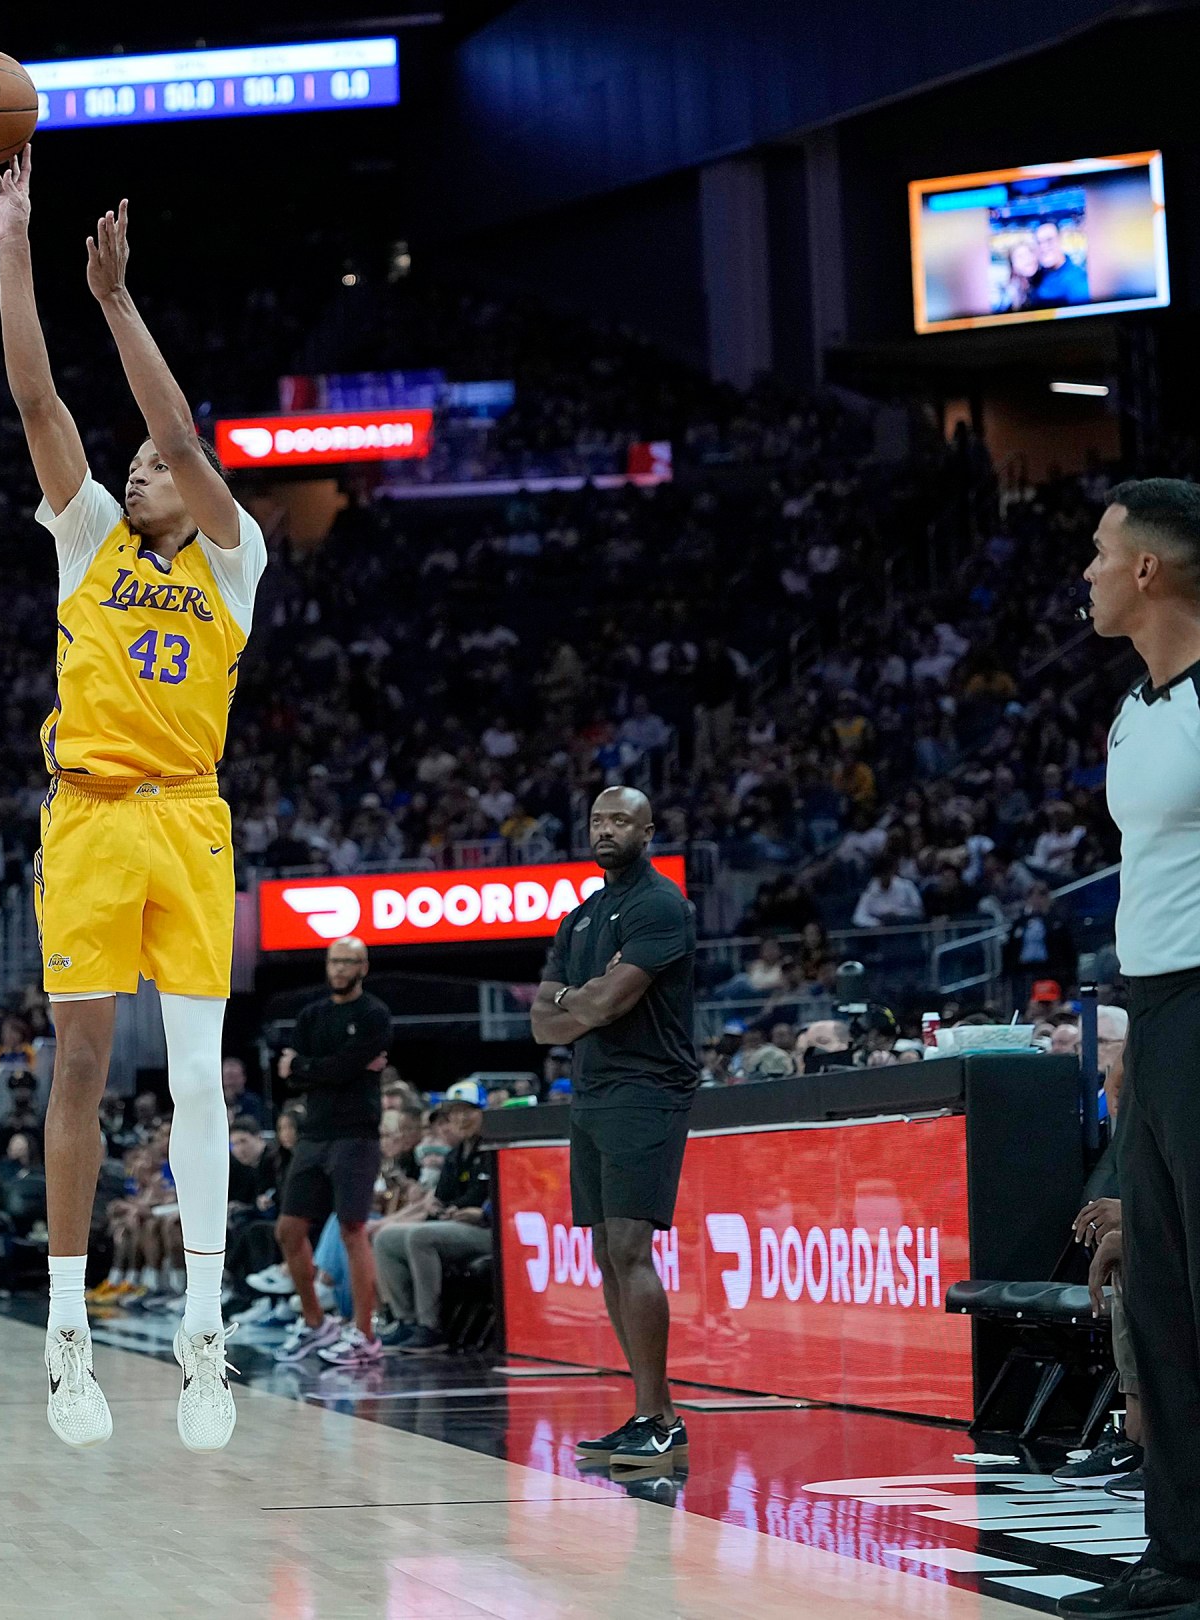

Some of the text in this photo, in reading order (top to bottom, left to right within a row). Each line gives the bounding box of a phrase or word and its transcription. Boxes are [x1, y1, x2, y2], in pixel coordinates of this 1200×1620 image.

[273, 422, 413, 454] DOORDASH
[127, 629, 191, 685] 43
[760, 1225, 941, 1307] DOORDASH
